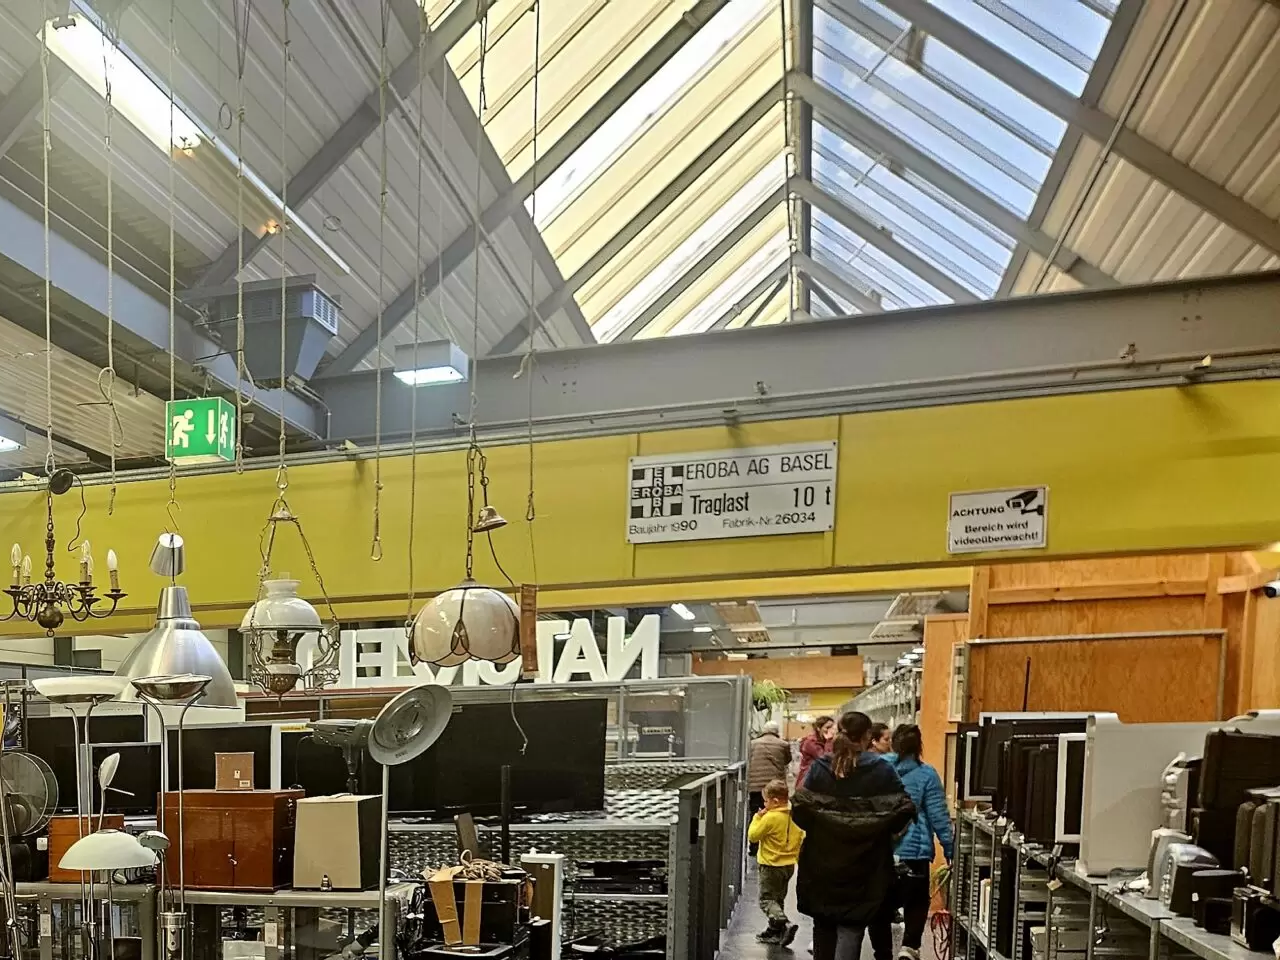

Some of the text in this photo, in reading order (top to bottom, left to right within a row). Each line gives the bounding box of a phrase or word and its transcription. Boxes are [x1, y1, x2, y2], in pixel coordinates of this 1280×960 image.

[686, 453, 833, 481] EROBA AG BASEL
[631, 484, 683, 499] EROBA
[690, 486, 831, 516] Traglast 10 t
[953, 506, 1005, 517] ACHTUNG
[629, 524, 667, 535] Baujahr
[774, 512, 816, 525] 26034
[964, 521, 1029, 533] Bereich wird
[954, 531, 1039, 545] videoüberwacht!
